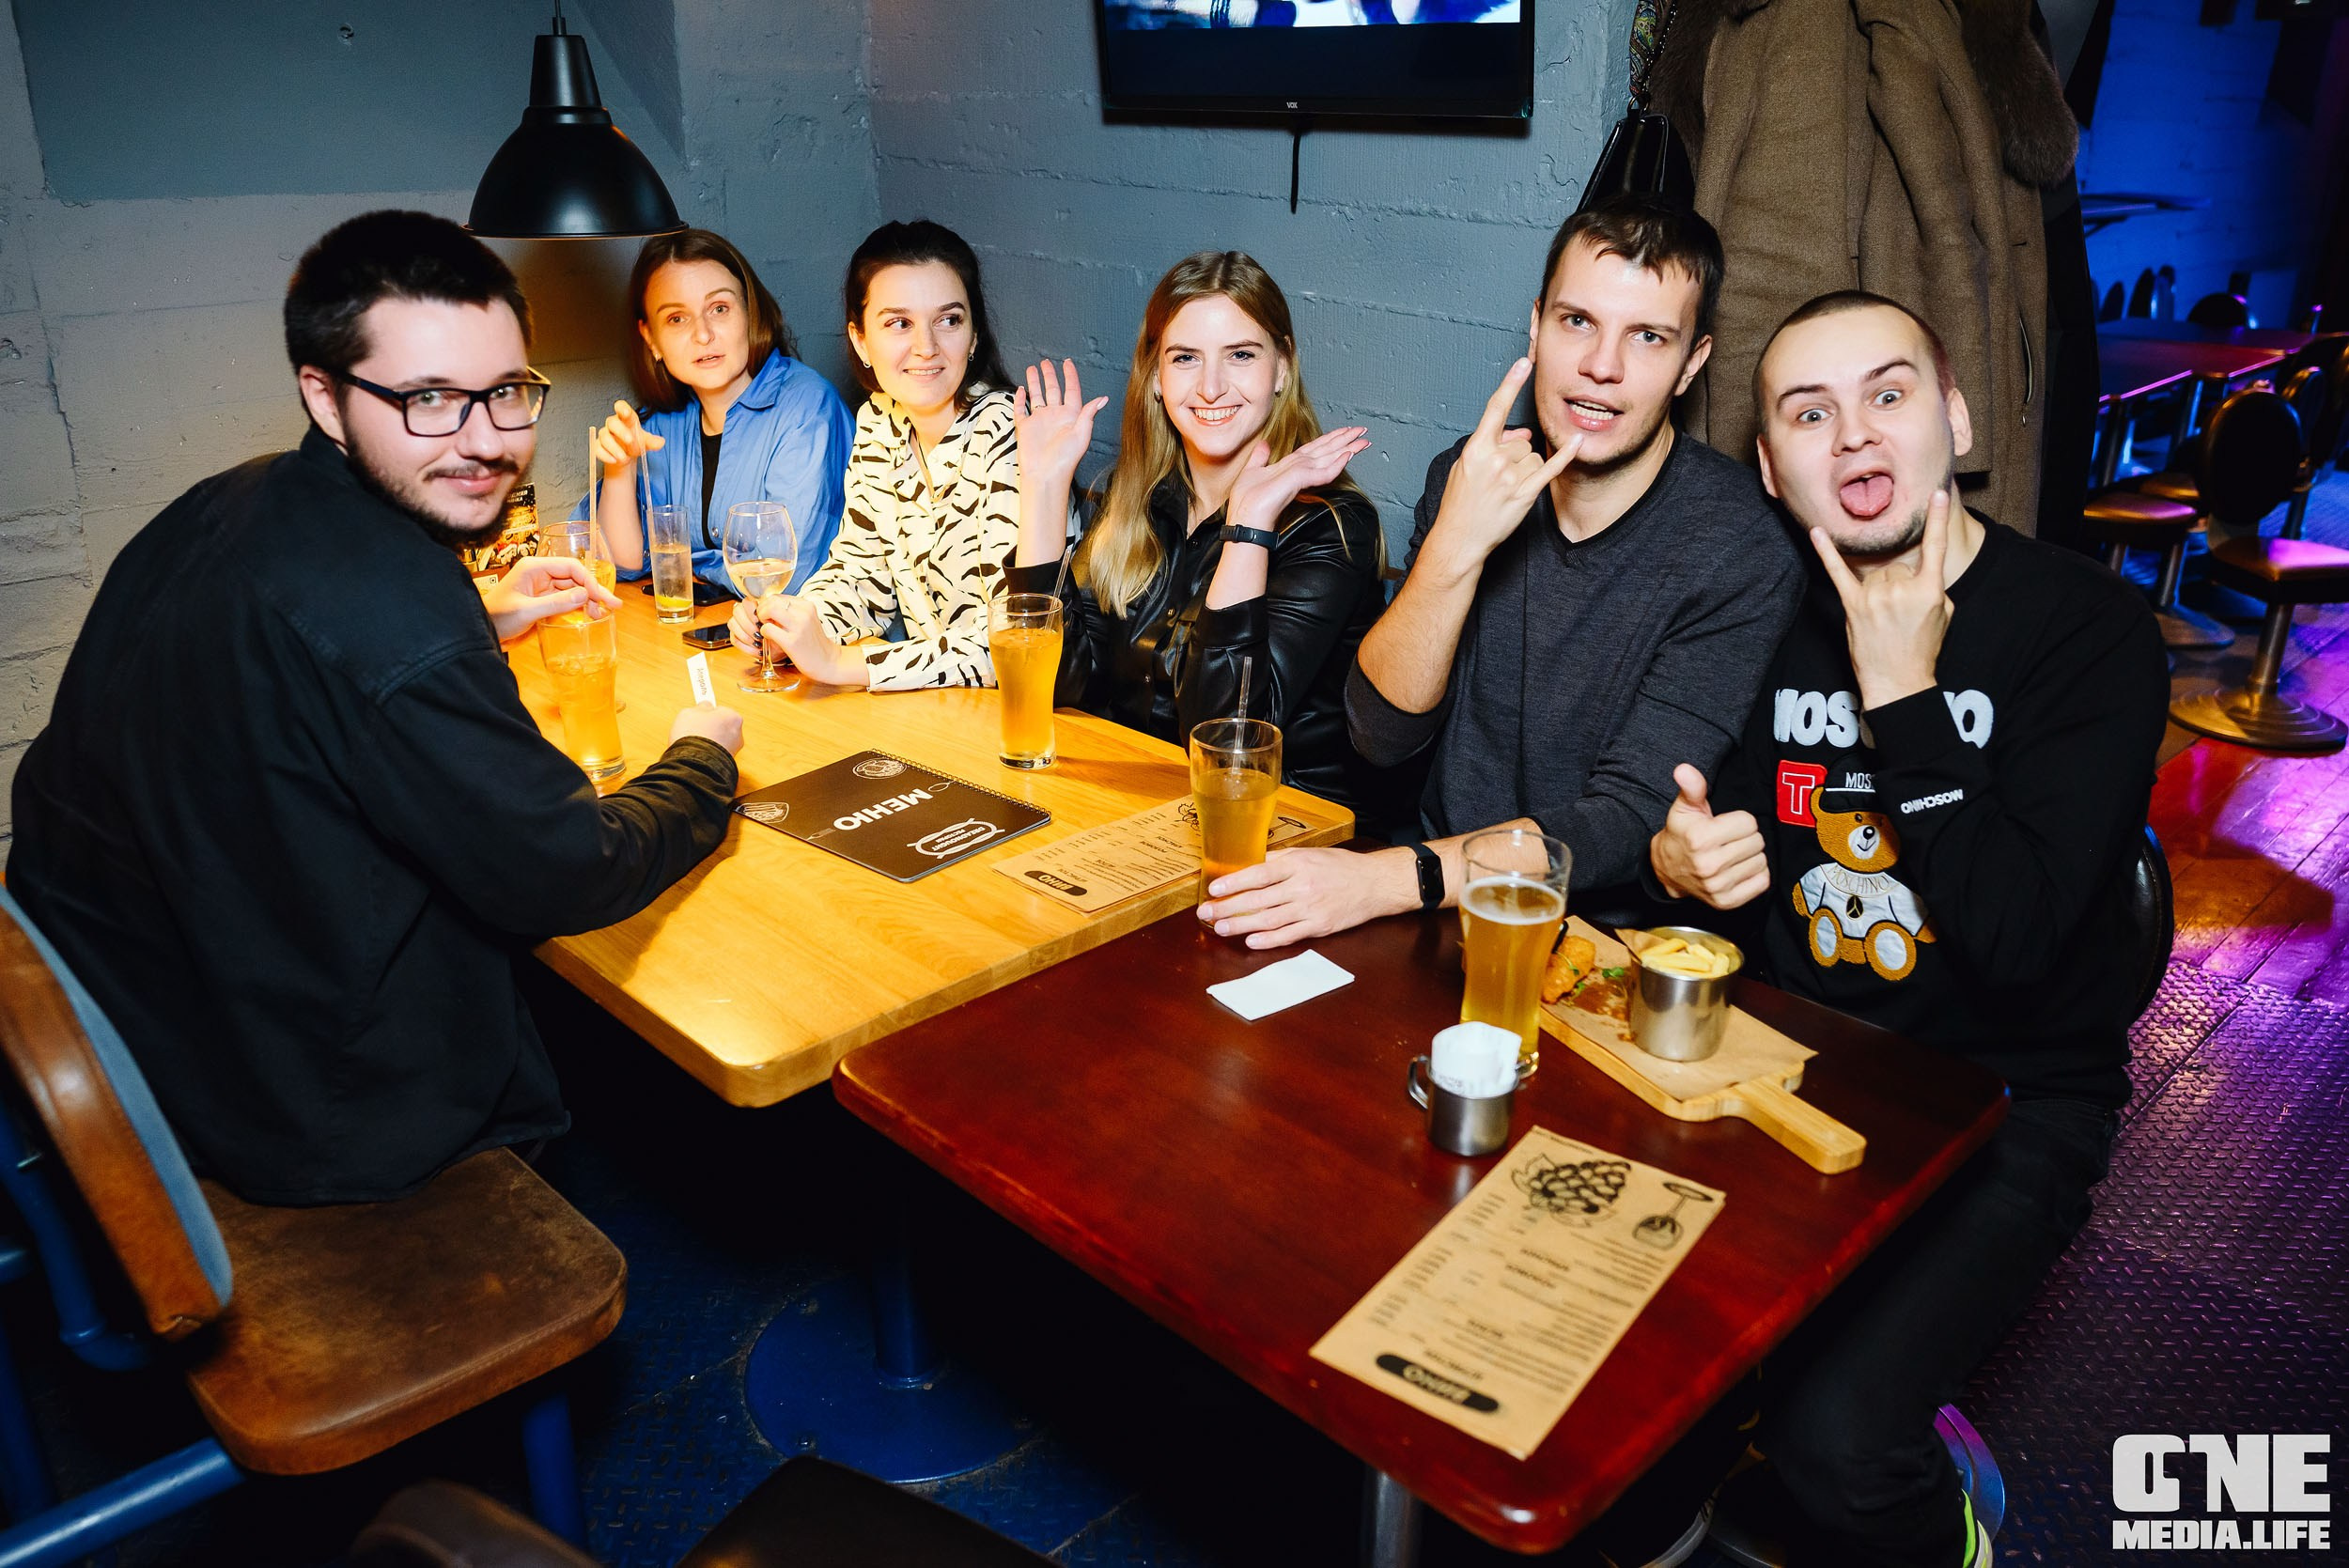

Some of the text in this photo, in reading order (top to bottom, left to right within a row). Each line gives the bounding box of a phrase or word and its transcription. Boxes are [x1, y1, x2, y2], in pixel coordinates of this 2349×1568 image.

[833, 788, 934, 831] МЕНЮ
[1900, 788, 1964, 815] MOSCHINO
[931, 826, 987, 851] DREADNOUGHT
[1037, 875, 1075, 891] ВИНО
